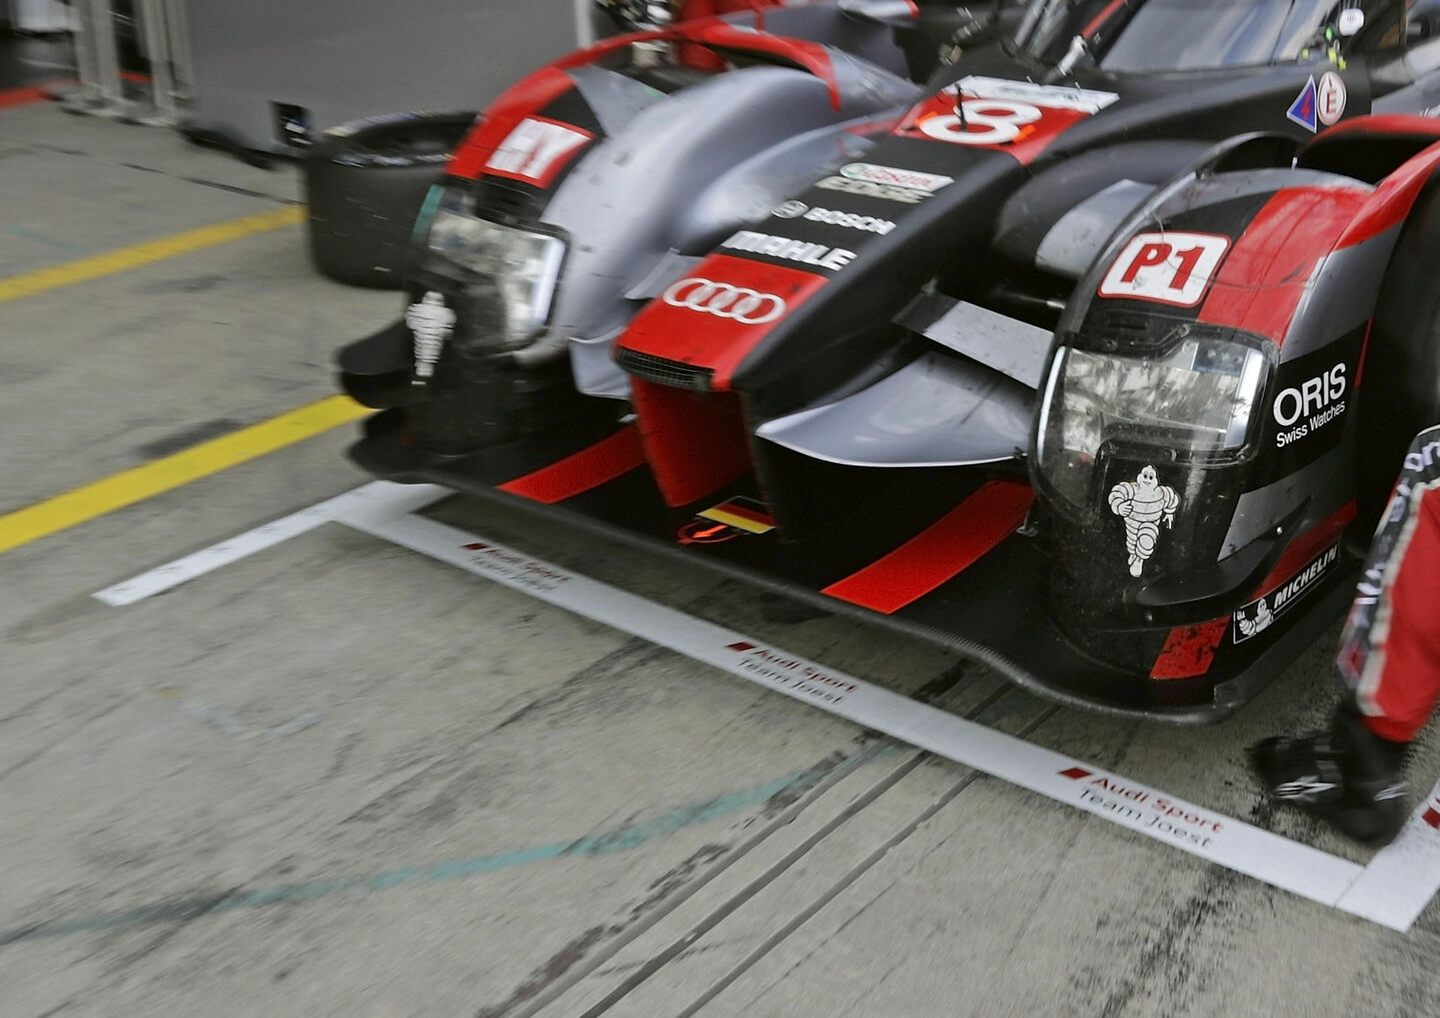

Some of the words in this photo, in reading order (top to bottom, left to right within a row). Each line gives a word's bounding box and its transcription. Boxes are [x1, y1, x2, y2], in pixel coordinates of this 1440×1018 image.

[919, 98, 1043, 145] 8
[1326, 91, 1337, 114] E
[802, 206, 898, 237] BOSCH
[1120, 243, 1206, 291] P1
[1272, 362, 1347, 427] ORIS
[1276, 423, 1308, 449] Swiss
[1309, 400, 1346, 433] Watches
[1273, 544, 1338, 610] MICHELIN
[738, 657, 791, 684] Team
[752, 649, 801, 671] Audi
[802, 666, 857, 694] Sport
[1079, 786, 1142, 820] Team
[1144, 815, 1214, 848] Joest
[1091, 777, 1149, 803] Audi
[1151, 797, 1223, 833] Sport
